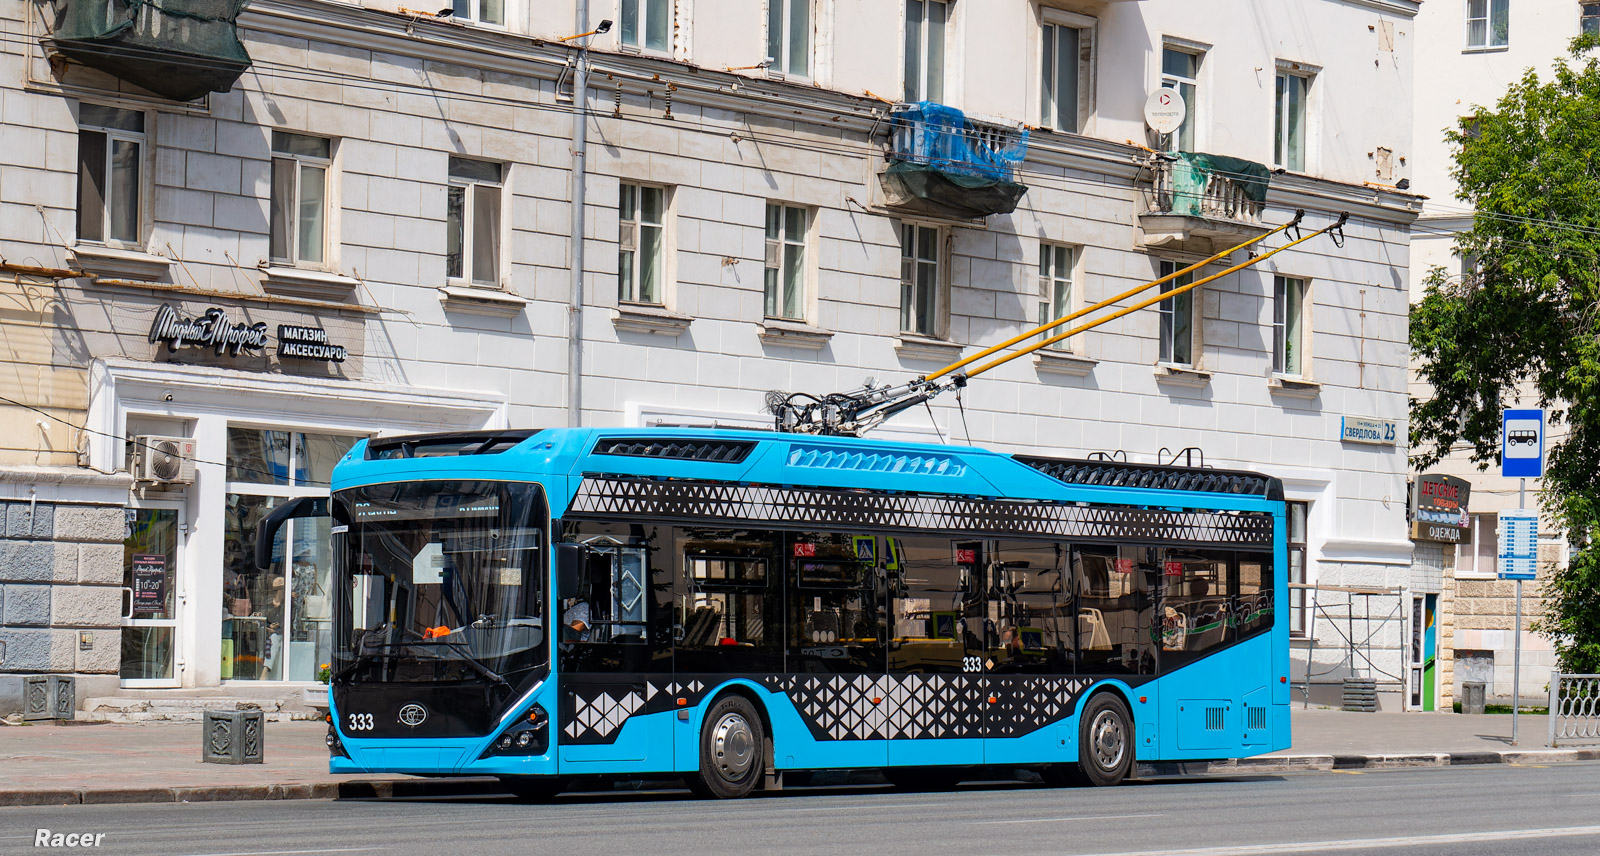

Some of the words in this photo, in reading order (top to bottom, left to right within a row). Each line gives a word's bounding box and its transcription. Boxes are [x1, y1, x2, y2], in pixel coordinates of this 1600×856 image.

[156, 305, 212, 350] Модный
[210, 311, 268, 354] Трофей
[283, 327, 328, 343] МАГАЗИН
[283, 342, 348, 360] АКСЕССУАРОВ
[1344, 427, 1381, 440] СВЕРДЛОВА
[1384, 422, 1396, 441] 25
[1421, 481, 1459, 499] ДЕТСКИЕ
[1429, 526, 1461, 542] ОДЕЖДА
[962, 656, 982, 673] 333
[348, 713, 375, 731] 333
